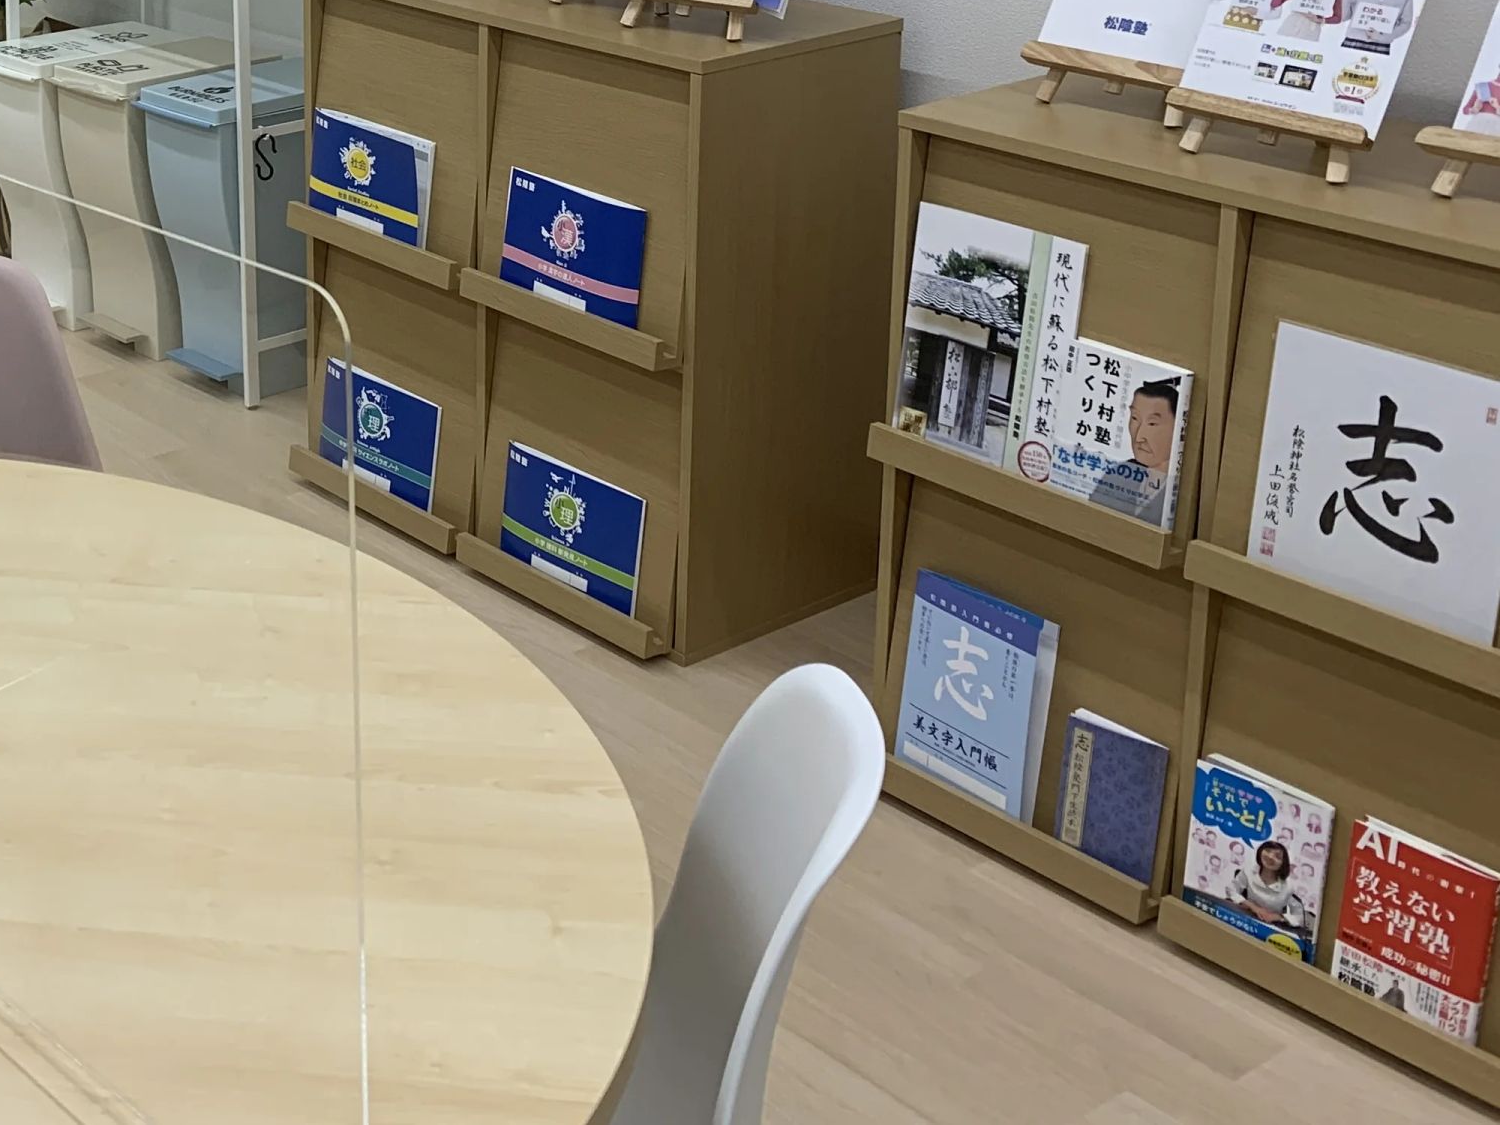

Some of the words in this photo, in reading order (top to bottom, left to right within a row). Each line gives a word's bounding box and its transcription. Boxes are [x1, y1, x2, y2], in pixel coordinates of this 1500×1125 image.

[1103, 15, 1148, 36] 松陰塾
[350, 157, 367, 172] 社会
[368, 414, 380, 432] 理
[1094, 357, 1122, 447] 松下村塾
[563, 485, 570, 494] N
[1319, 394, 1455, 564] 志
[560, 507, 574, 526] 理
[934, 626, 994, 721] 志
[913, 713, 999, 773] 美文字入門帳
[1355, 866, 1456, 922] 教えない
[1353, 892, 1451, 961] 学習塾
